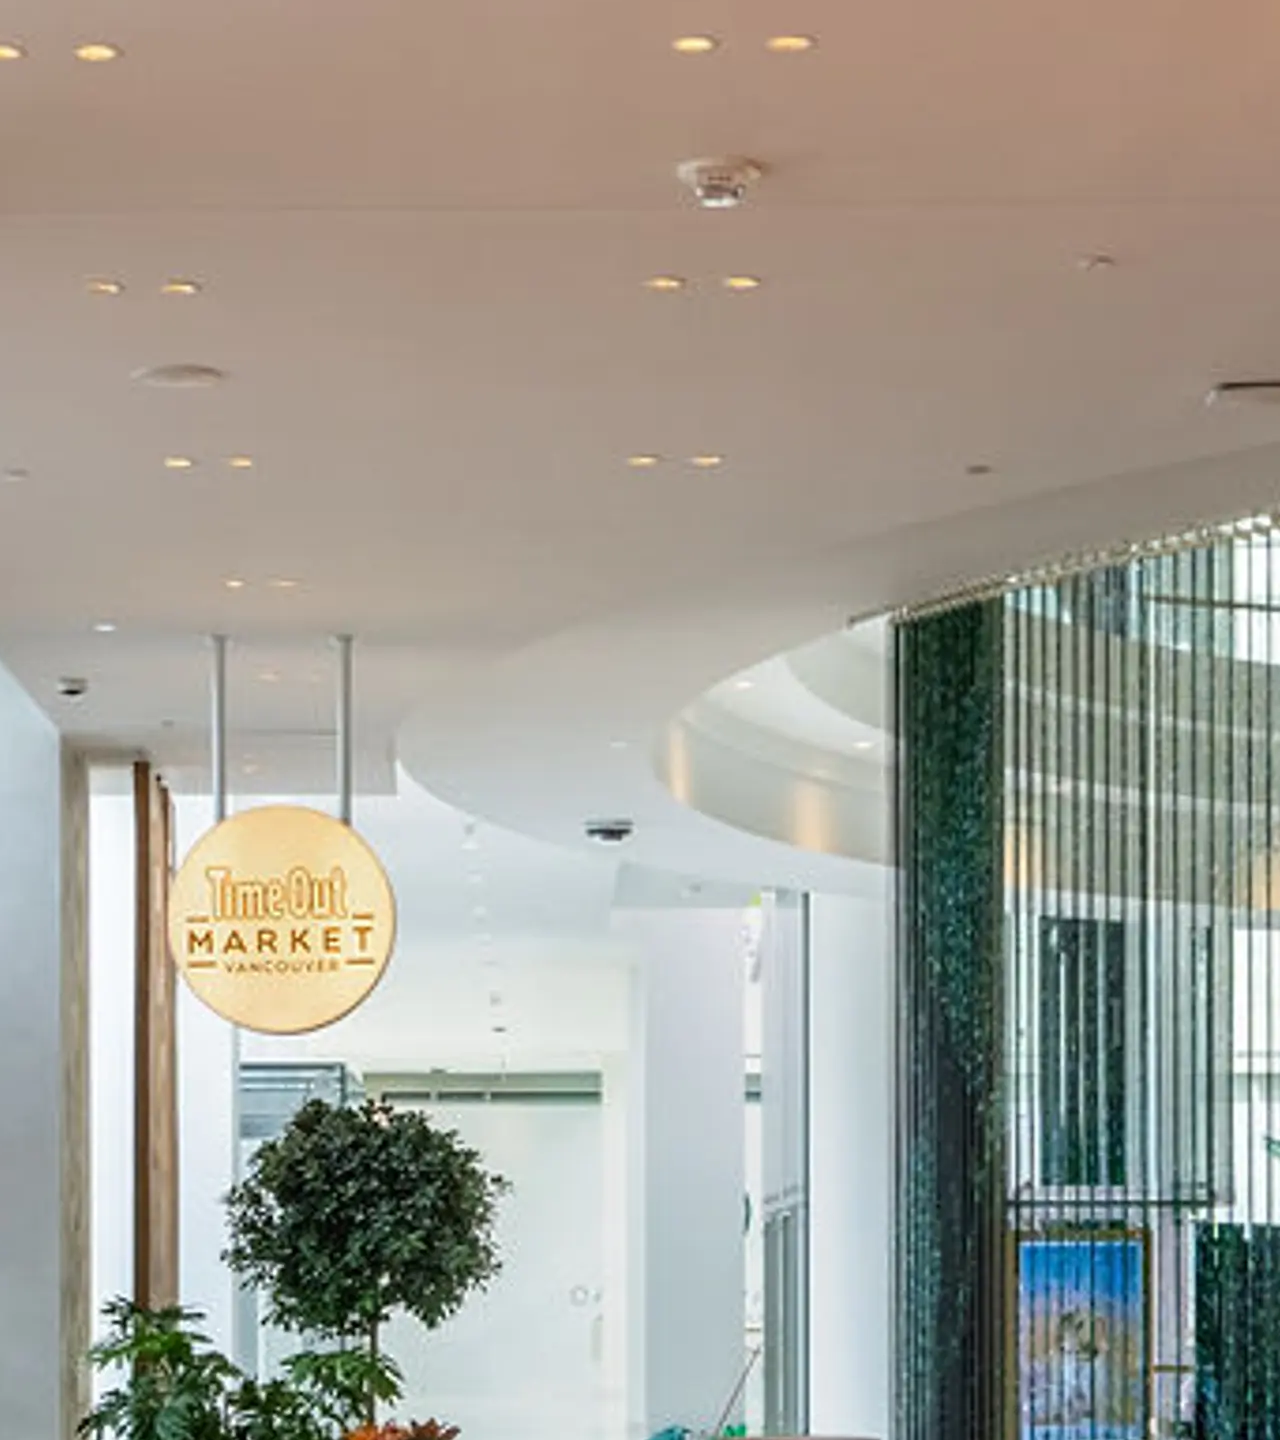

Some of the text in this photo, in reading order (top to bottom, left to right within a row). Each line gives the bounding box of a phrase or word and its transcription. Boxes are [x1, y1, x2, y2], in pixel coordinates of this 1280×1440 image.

[205, 865, 348, 920] Time Out
[187, 926, 374, 954] MARKET
[224, 960, 340, 974] VANCOUVER
